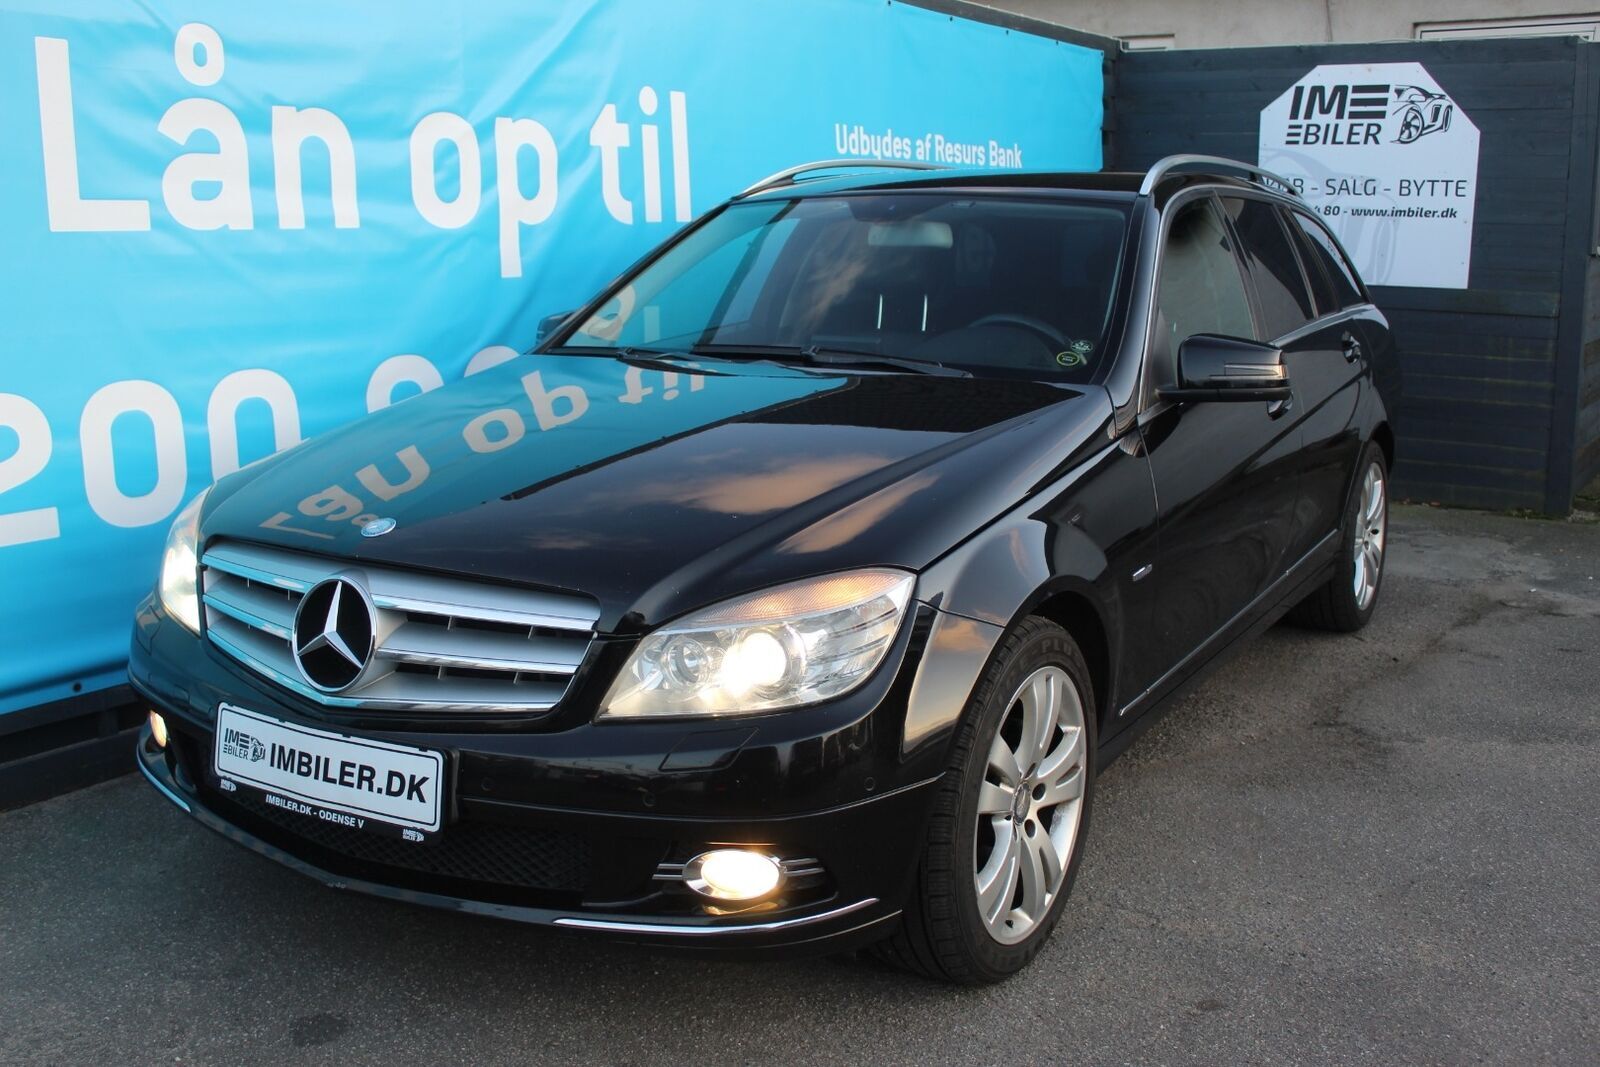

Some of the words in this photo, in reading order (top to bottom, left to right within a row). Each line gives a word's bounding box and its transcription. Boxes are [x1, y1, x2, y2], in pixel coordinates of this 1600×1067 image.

[35, 22, 360, 232] Lån
[409, 111, 558, 278] op
[589, 85, 692, 226] til
[835, 123, 911, 160] Udbydes
[915, 133, 932, 160] af
[934, 134, 985, 166] Resurs
[988, 140, 1022, 168] Bank
[1325, 178, 1377, 196] SALG
[1398, 179, 1468, 198] BYTTE
[1323, 205, 1340, 216] 80
[1351, 205, 1458, 219] www.imbiler.dk
[269, 742, 430, 804] IMBILER.DK
[266, 795, 312, 815] IMBILER.DK
[318, 809, 356, 827] ODENSE
[357, 818, 365, 829] V
